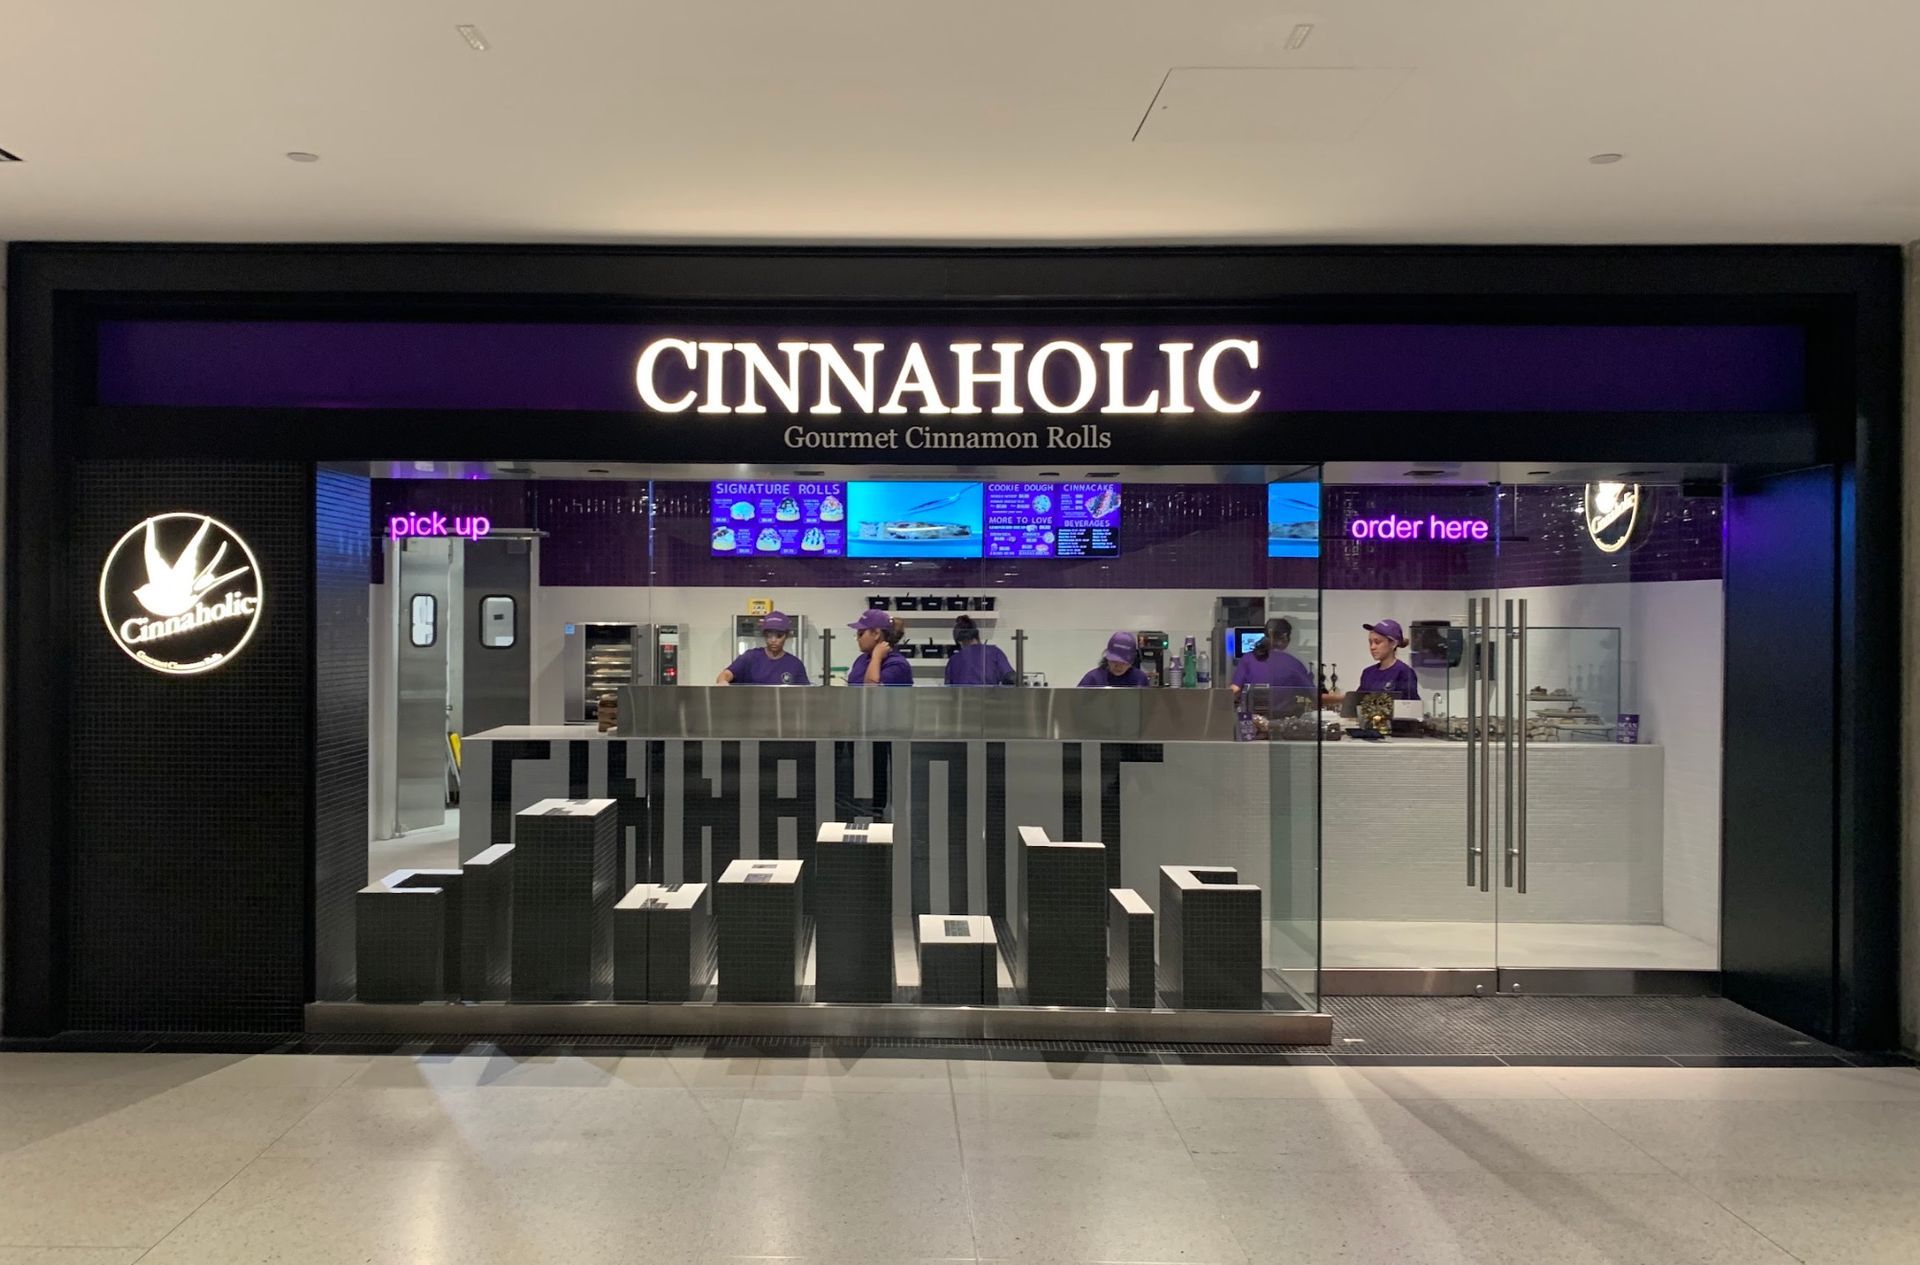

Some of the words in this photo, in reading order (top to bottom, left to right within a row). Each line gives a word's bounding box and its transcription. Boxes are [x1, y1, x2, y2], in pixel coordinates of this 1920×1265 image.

[635, 337, 1262, 415] CINNAHOLIC
[783, 424, 898, 450] Gourmet
[904, 425, 1039, 450] Cinnamon
[1047, 424, 1112, 449] Rolls
[715, 483, 791, 495] SIGNATURE
[798, 483, 840, 495] ROLLS
[988, 483, 1020, 492] COOKIE
[1024, 483, 1054, 492] DOUGH
[1063, 483, 1114, 492] CINNACAKE
[390, 511, 447, 541] pick
[455, 516, 490, 541] up
[988, 516, 1013, 525] MORE
[1017, 516, 1029, 525] TO
[1032, 516, 1053, 525] LOVE
[1064, 519, 1111, 528] BEVERAGES
[1351, 514, 1424, 540] order
[1429, 514, 1489, 540] here
[120, 591, 256, 644] Cinnaholic
